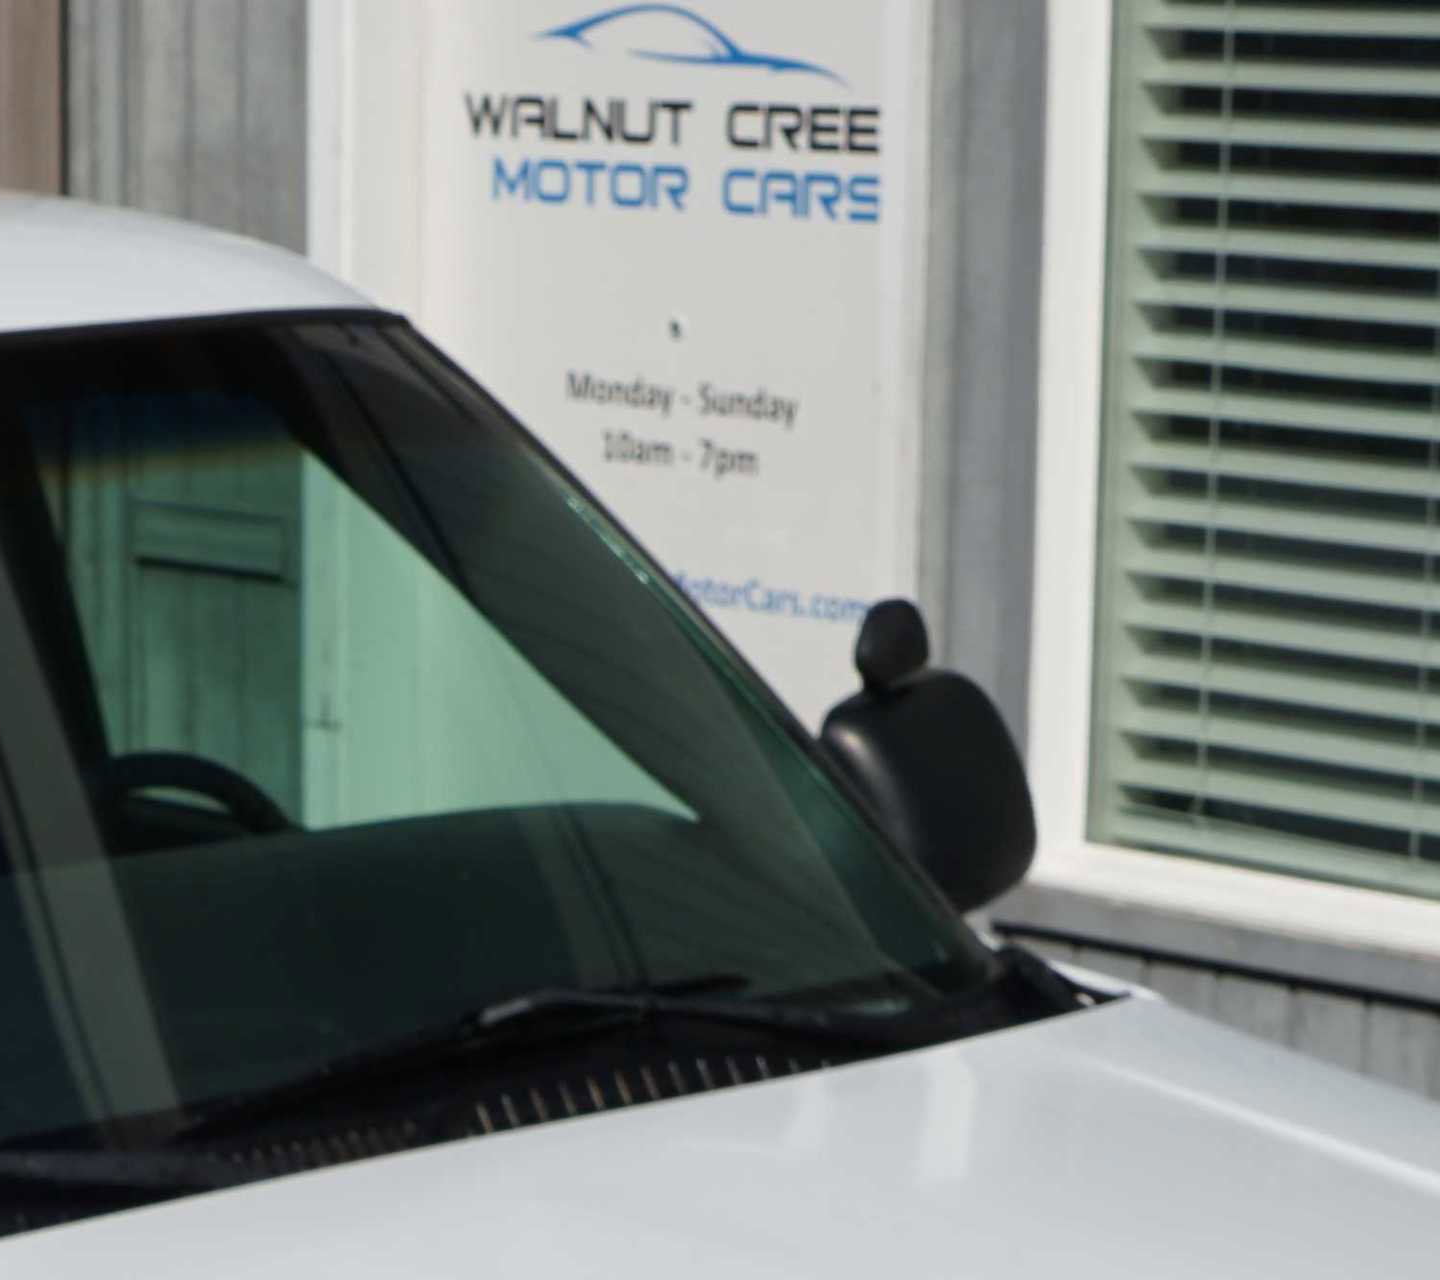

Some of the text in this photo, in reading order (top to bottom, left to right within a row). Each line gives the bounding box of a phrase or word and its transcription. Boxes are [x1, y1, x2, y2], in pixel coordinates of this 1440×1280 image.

[465, 92, 881, 154] WALNUT CREE
[492, 157, 881, 222] MOTOR CARS
[568, 371, 674, 417] Monday
[698, 382, 799, 428] Sunday
[602, 430, 673, 467] 10am
[698, 439, 759, 480] 7pm
